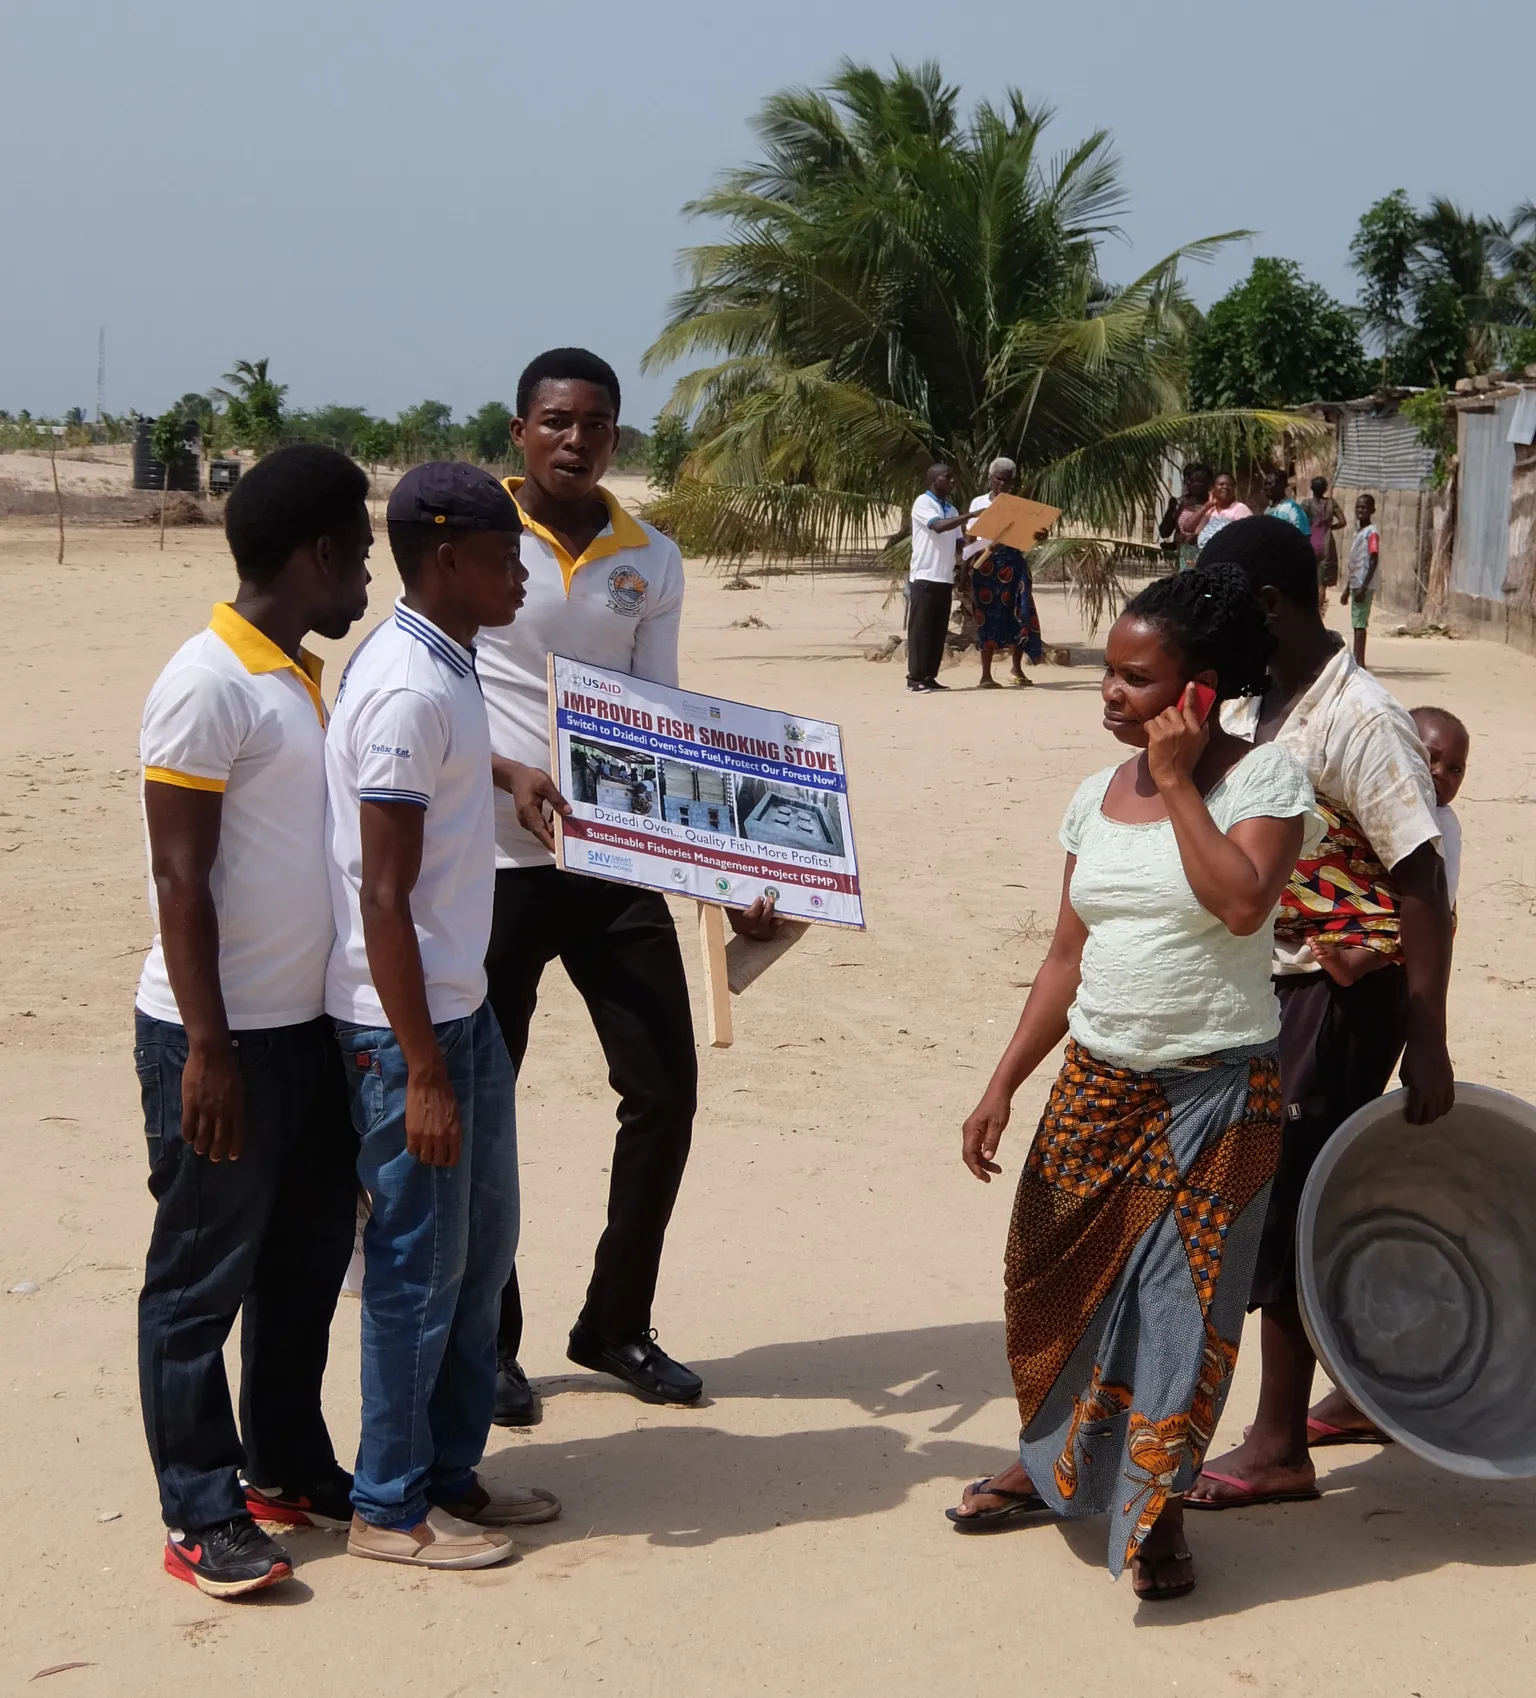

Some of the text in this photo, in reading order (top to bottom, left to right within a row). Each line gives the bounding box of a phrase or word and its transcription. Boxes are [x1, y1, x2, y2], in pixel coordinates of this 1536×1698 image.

[582, 676, 622, 695] USAID
[563, 690, 653, 731] IMPROVED
[657, 716, 696, 742] FISH
[699, 727, 780, 761] SMOKING
[784, 745, 838, 772] STOVE
[566, 715, 837, 786] Switch to Dzidedi Oven; Save Fuel, Protect Our Forest Now!
[586, 827, 838, 889] Sustainable Fisheries Management Project (SFMP)
[587, 850, 611, 863] SNV
[594, 808, 639, 828] Dzidedi
[643, 819, 683, 839] Oven...
[685, 829, 726, 849] Quality
[757, 844, 788, 860] More
[791, 852, 832, 868] Profits!
[611, 855, 633, 864] SMART
